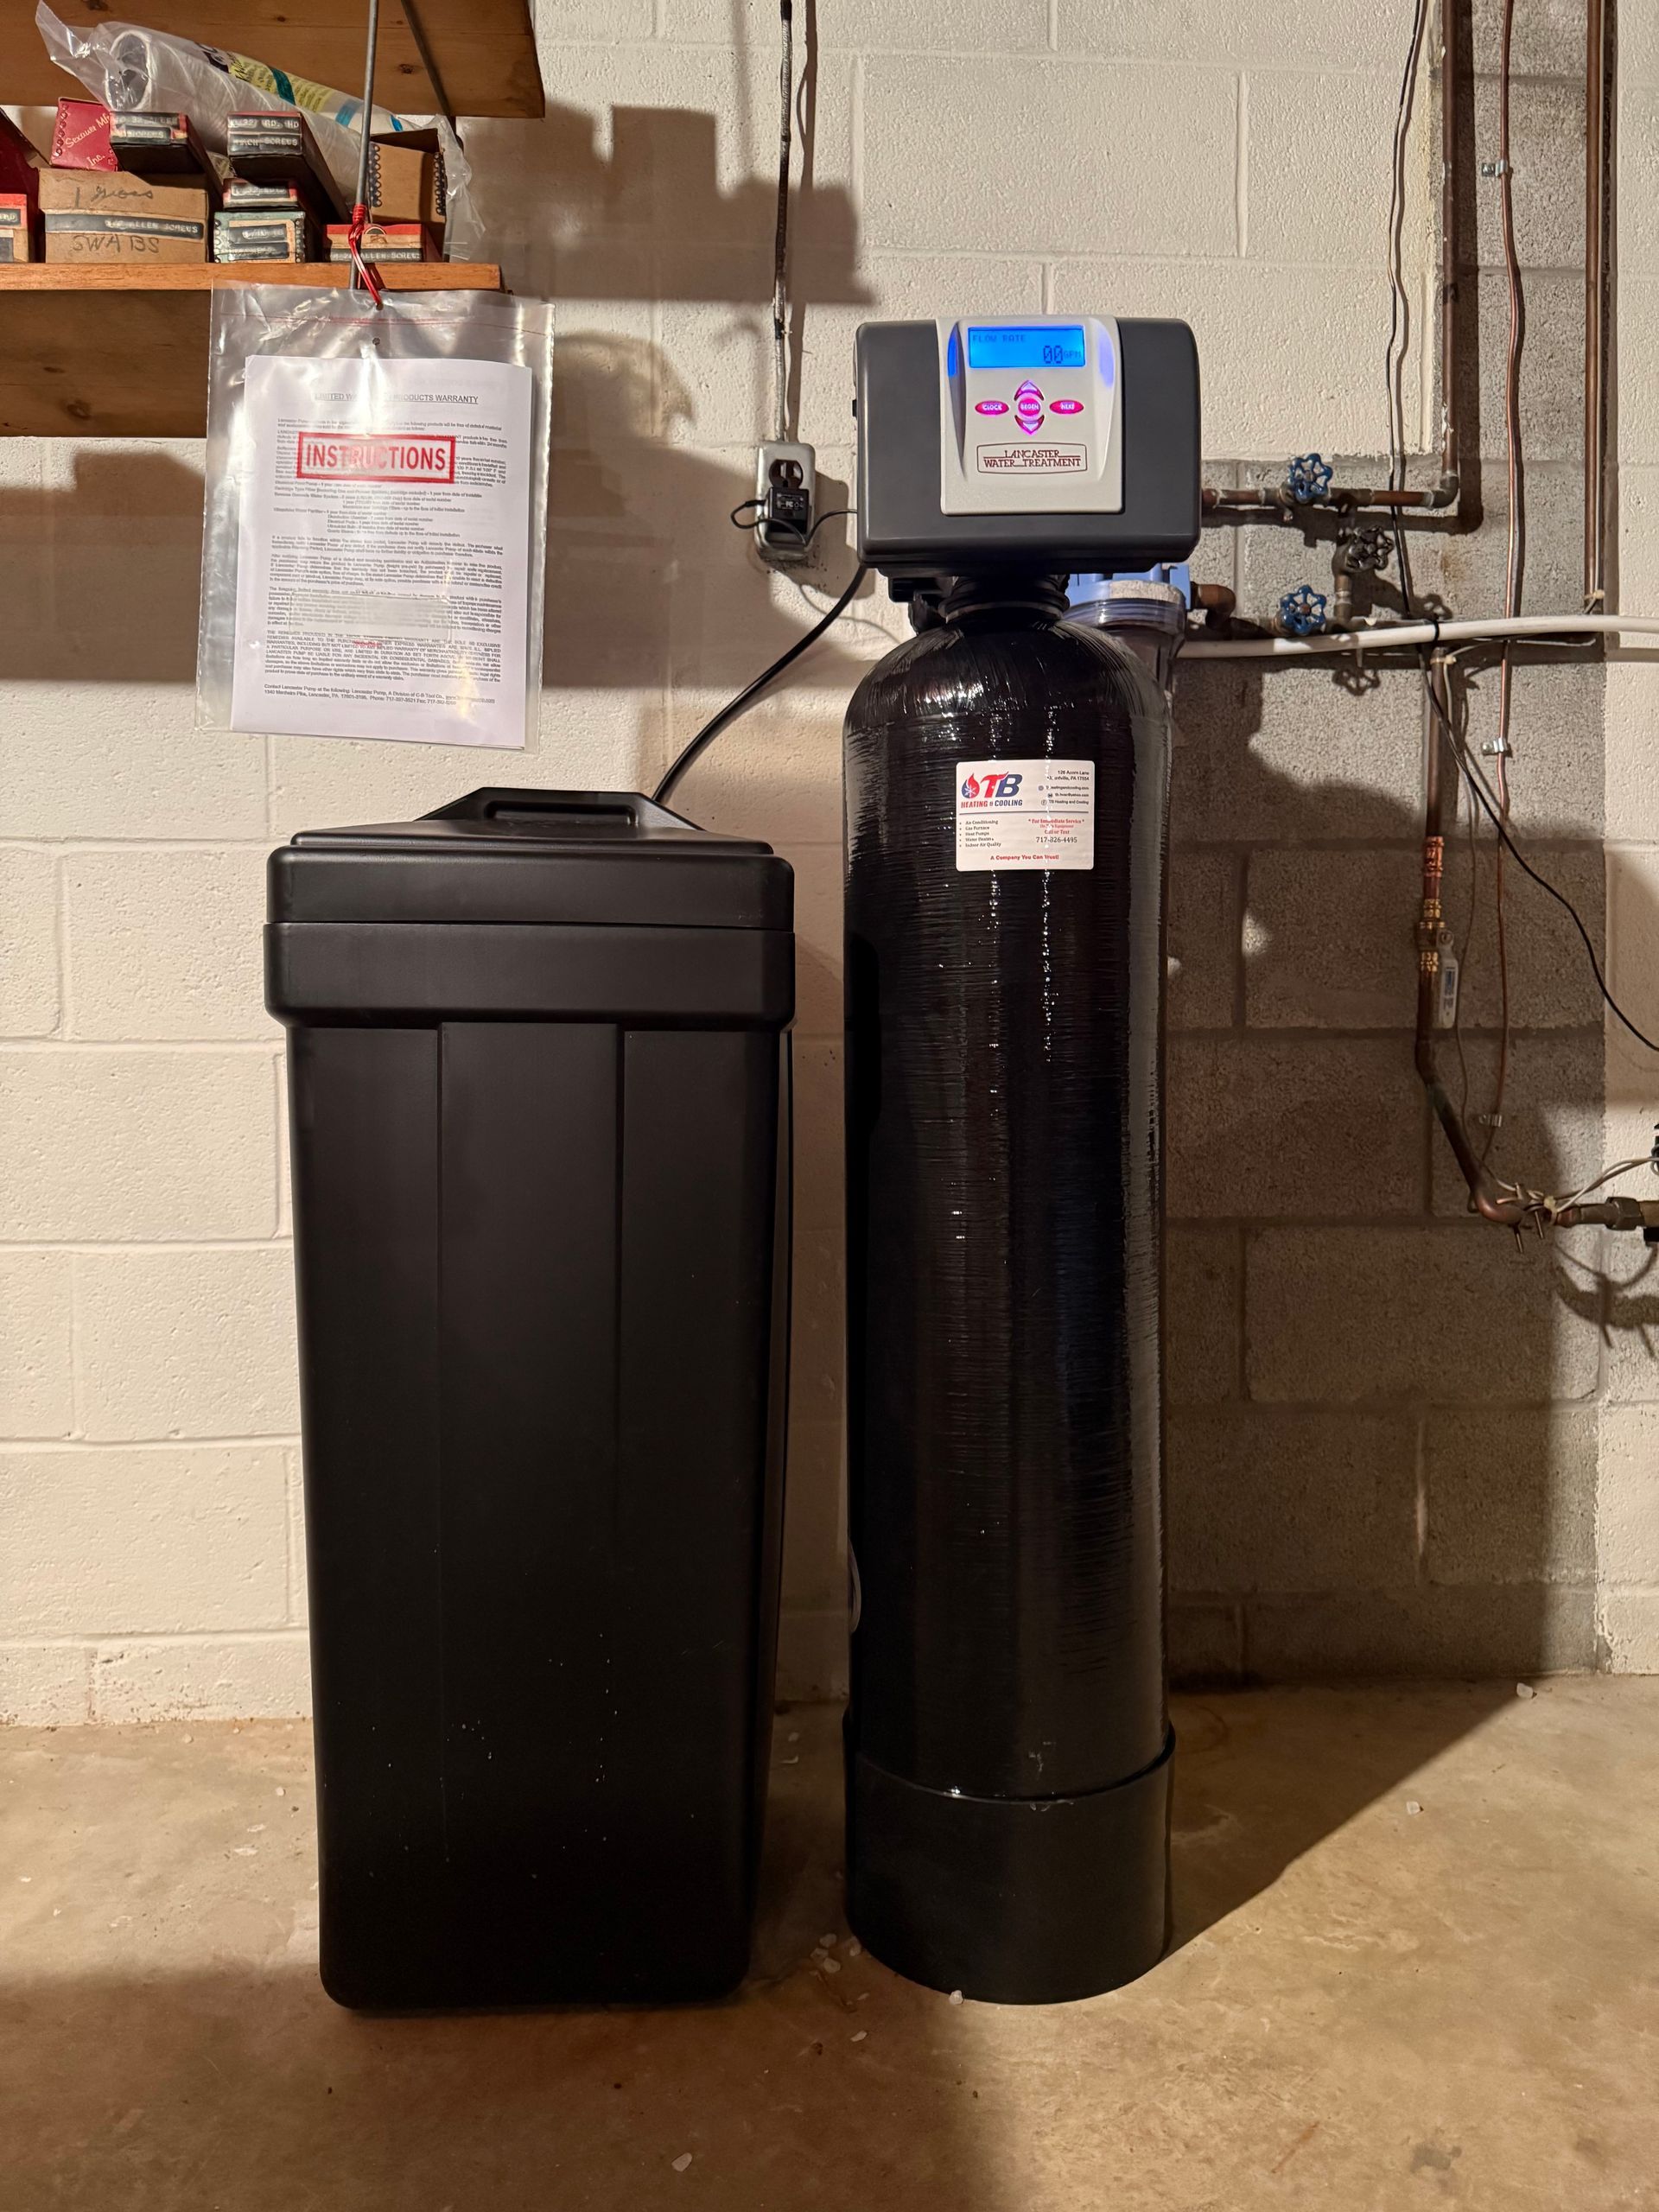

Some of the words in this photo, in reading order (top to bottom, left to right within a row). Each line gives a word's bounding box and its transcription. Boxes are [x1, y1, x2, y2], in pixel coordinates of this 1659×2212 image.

[65, 125, 97, 148] Sexauer
[86, 155, 105, 167] Inc.
[973, 334, 996, 343] FLOW
[435, 394, 479, 404] WARRANTY
[306, 443, 446, 471] INSTRUCTIONS
[1004, 449, 1060, 458] LANCASTER
[984, 459, 1015, 467] WATER
[1023, 458, 1081, 467] TREATMENT
[981, 771, 1023, 798] TB
[961, 800, 988, 809] HEATING
[995, 798, 1023, 807] COOLING
